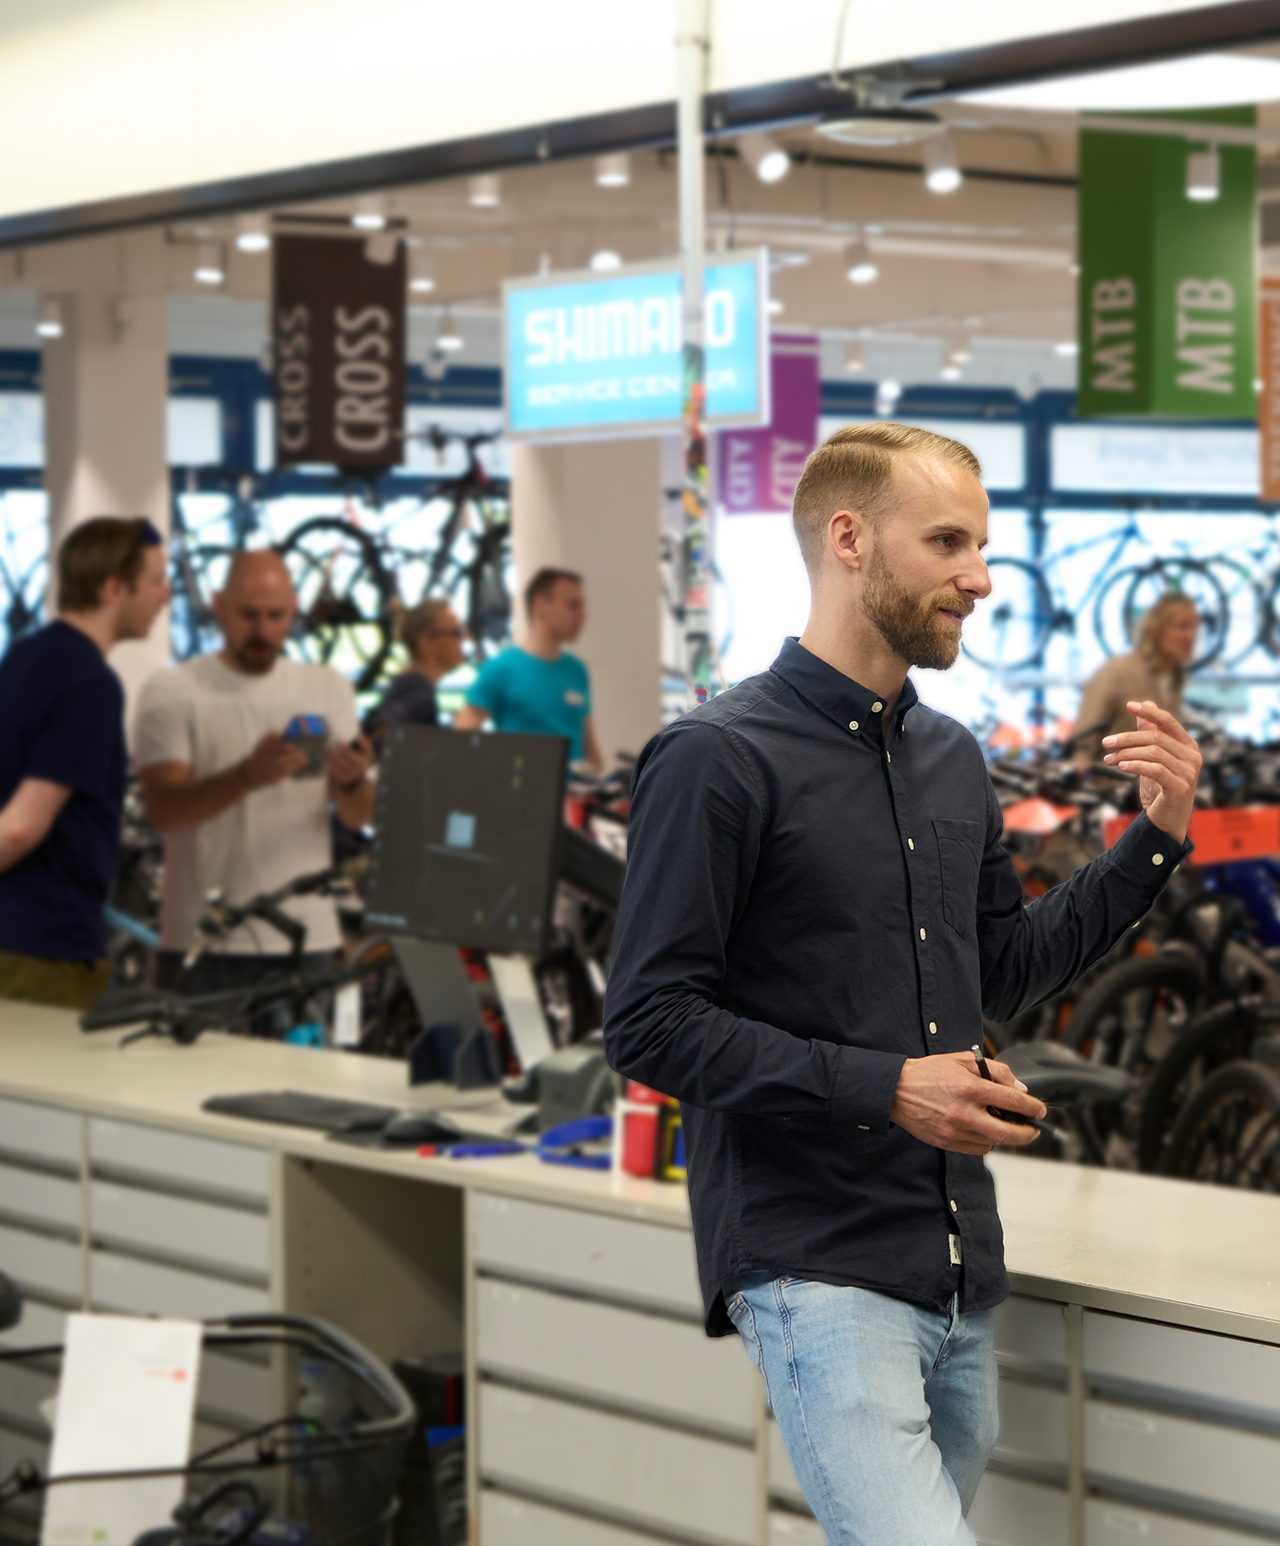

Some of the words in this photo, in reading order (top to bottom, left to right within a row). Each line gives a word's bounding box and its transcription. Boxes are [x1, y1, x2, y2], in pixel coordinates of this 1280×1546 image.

[279, 304, 309, 451] CROSS
[334, 305, 390, 452] CROSS
[527, 379, 622, 406] SERVICE
[626, 369, 738, 399] CENER
[1092, 277, 1136, 392] MTB
[1176, 277, 1235, 395] MTB
[728, 440, 753, 506] CITY
